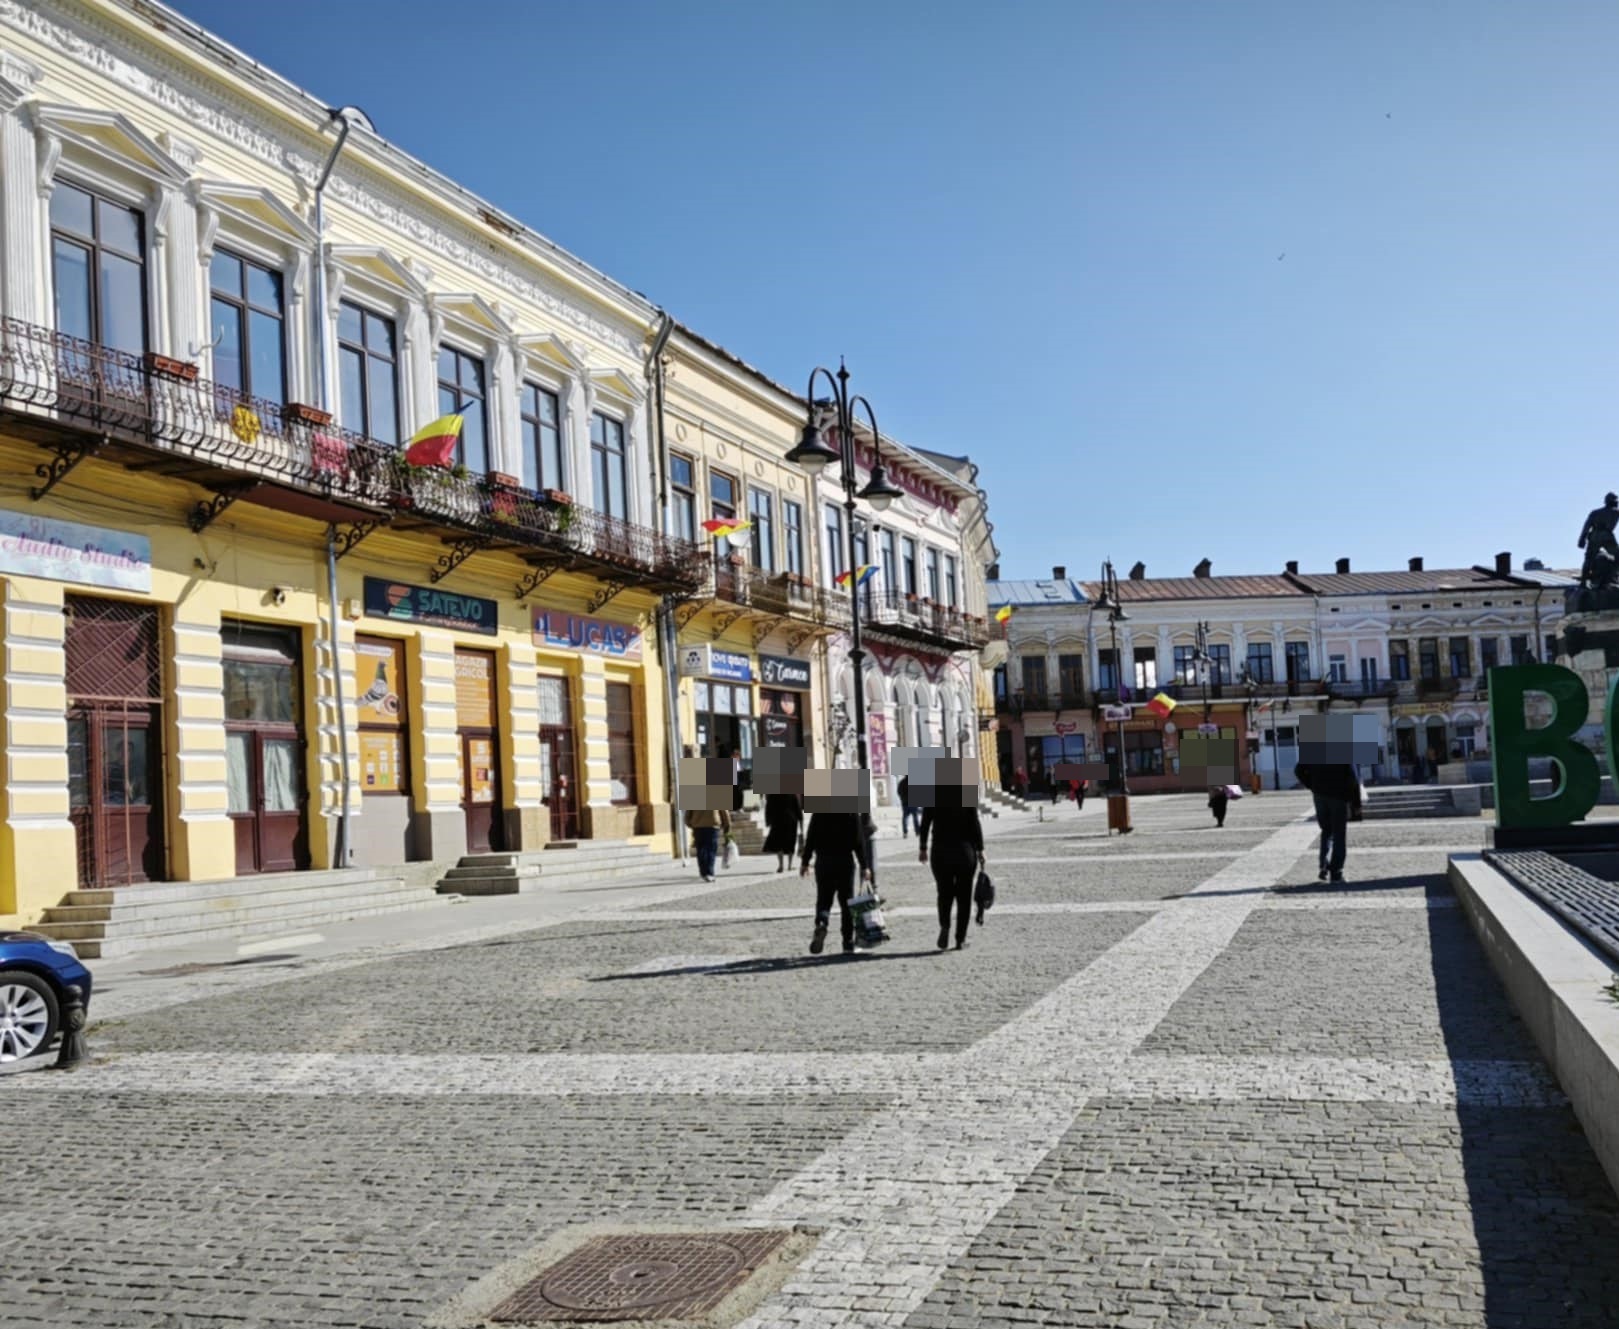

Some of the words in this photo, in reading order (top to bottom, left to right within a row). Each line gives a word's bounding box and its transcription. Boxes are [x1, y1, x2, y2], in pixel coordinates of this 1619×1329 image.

[417, 590, 482, 620] SATEVO
[544, 612, 627, 656] LUCAS
[455, 664, 489, 680] GRICOL
[1488, 663, 1619, 828] B
